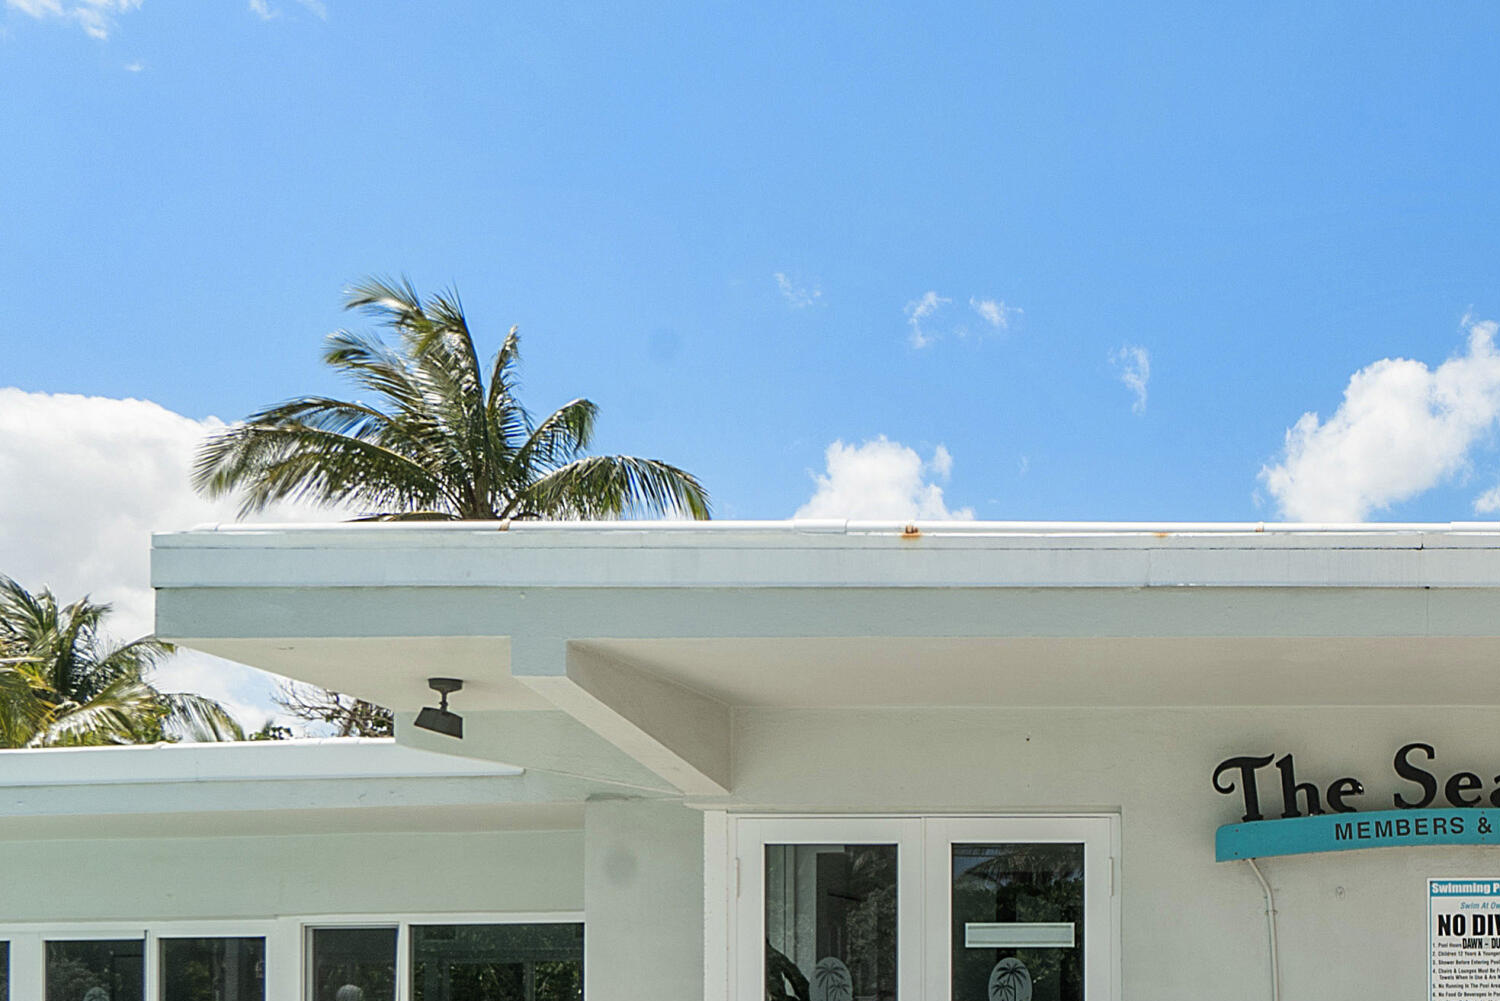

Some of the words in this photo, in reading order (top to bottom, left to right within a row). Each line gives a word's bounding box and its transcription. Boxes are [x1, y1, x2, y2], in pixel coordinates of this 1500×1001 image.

[1212, 753, 1364, 823] The
[1335, 817, 1464, 841] MEMBERS
[1477, 817, 1492, 834] &
[1432, 882, 1490, 894] Swimming
[1460, 902, 1479, 910] Swim
[1480, 902, 1488, 910] At
[1438, 914, 1466, 936] NO
[1462, 938, 1482, 949] DAWN
